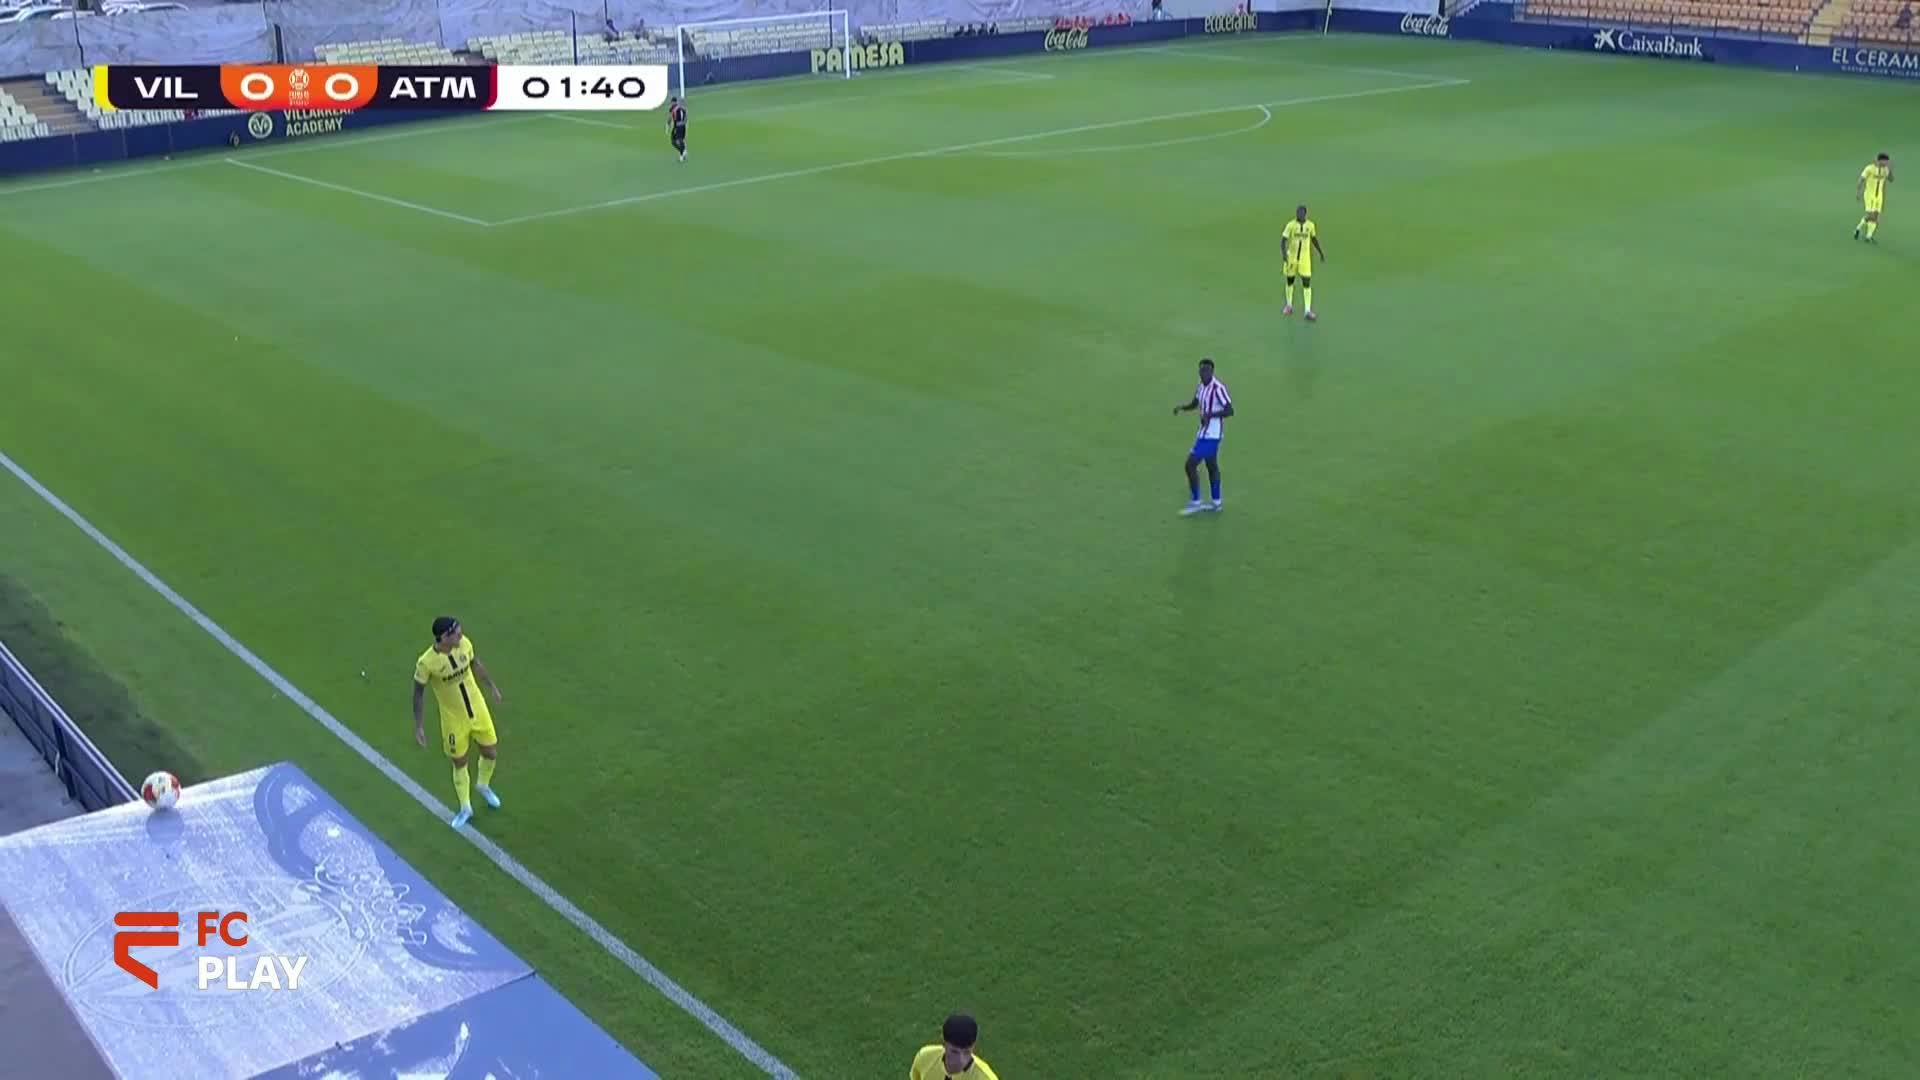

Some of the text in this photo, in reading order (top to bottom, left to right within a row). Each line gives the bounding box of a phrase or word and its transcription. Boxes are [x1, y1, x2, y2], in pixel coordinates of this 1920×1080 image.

[1618, 31, 1702, 56] CaixaBank
[811, 41, 904, 73] PAMESA
[1832, 48, 1919, 70] EL CERAM
[286, 118, 343, 136] ACADEMY
